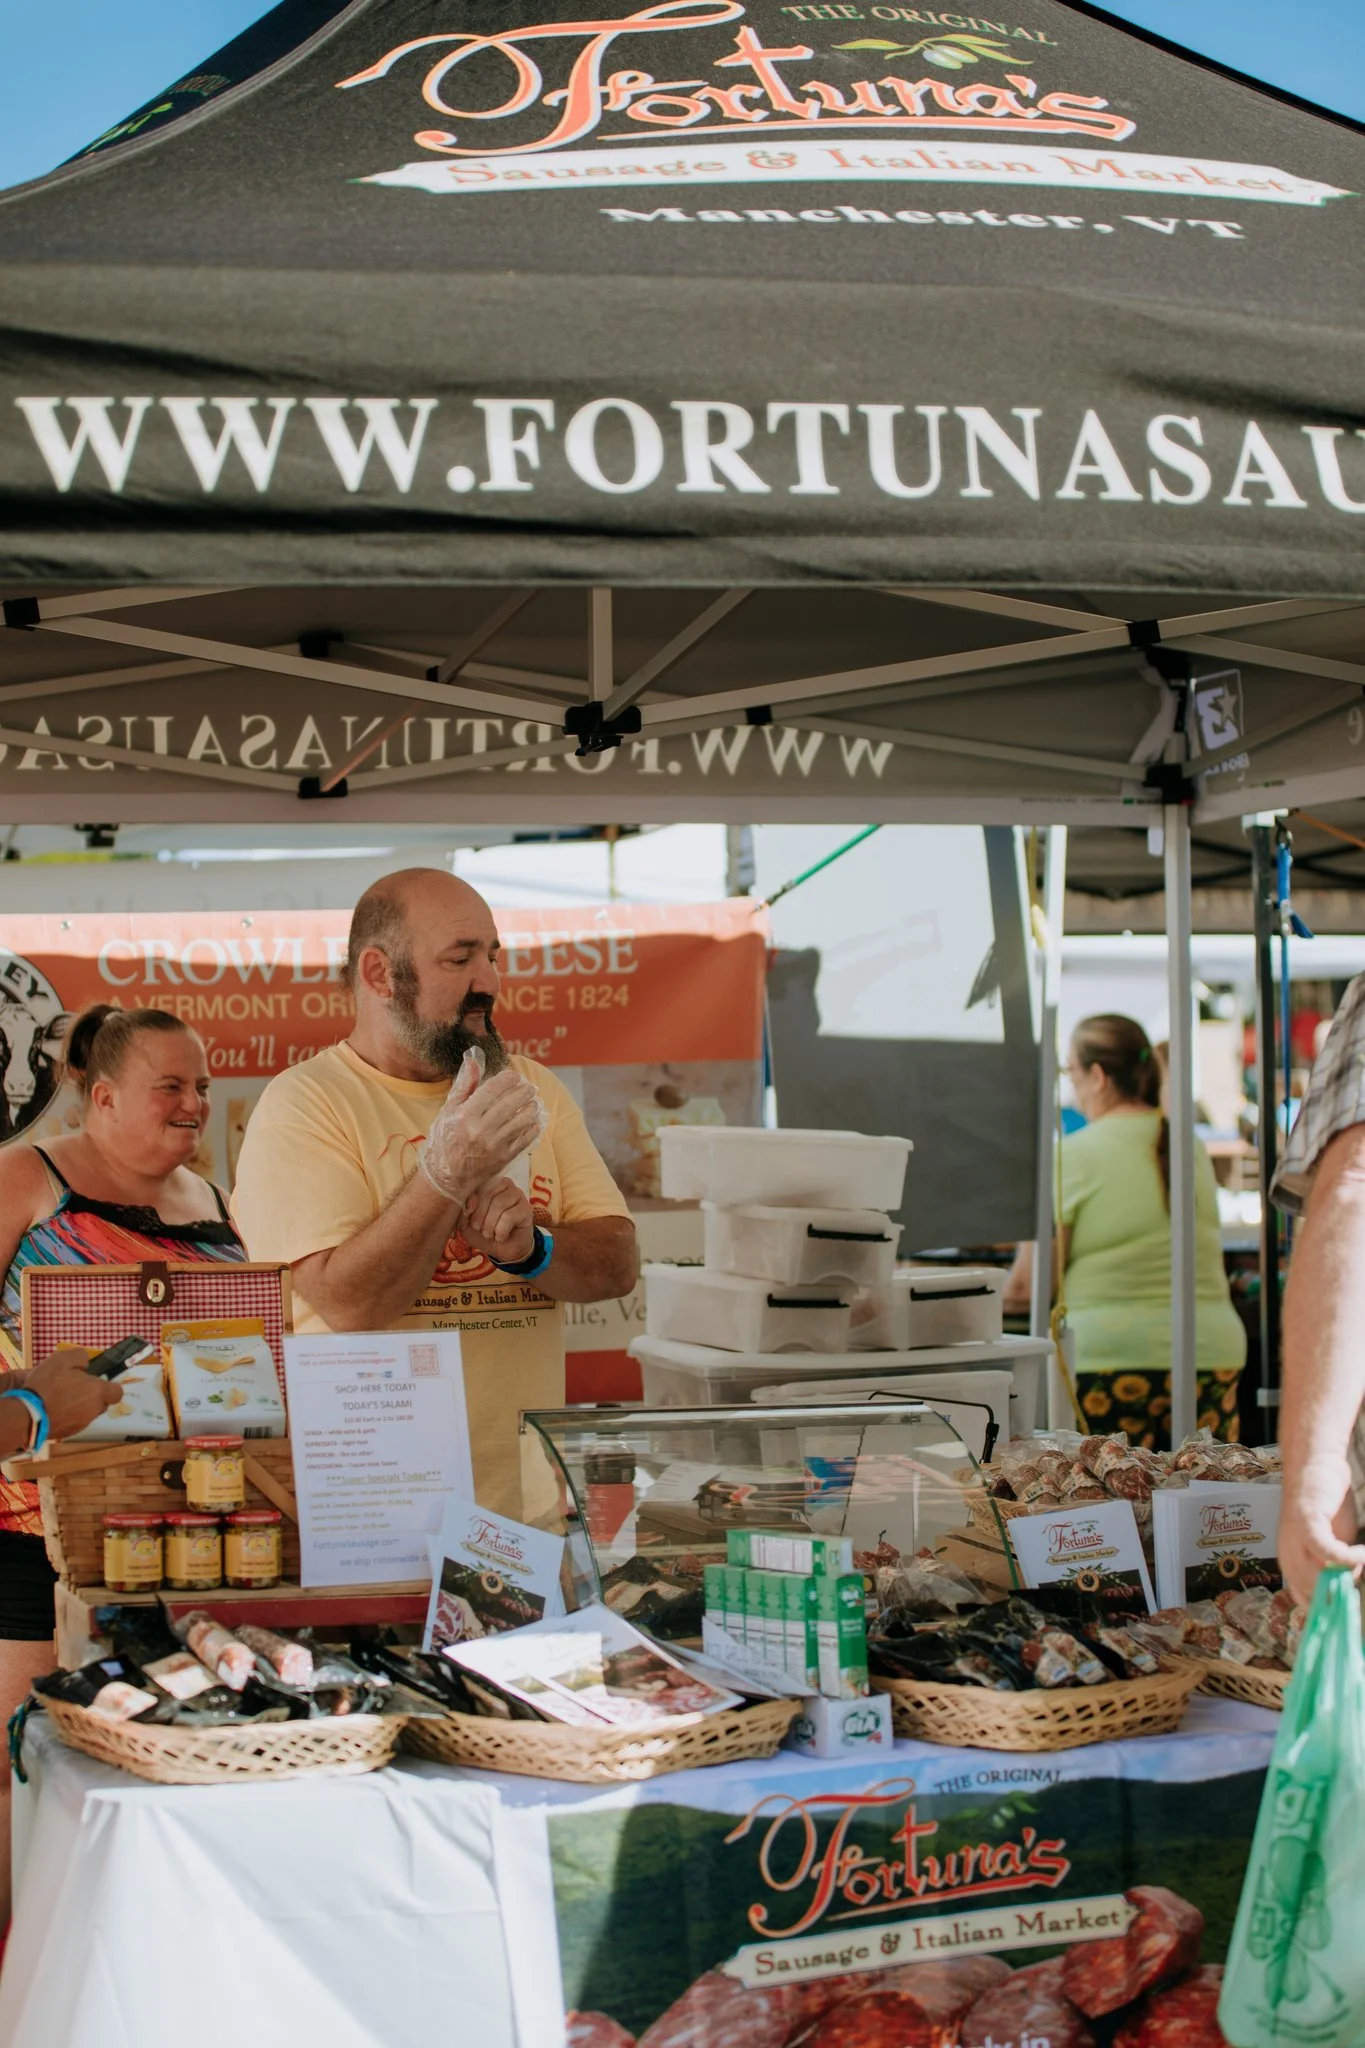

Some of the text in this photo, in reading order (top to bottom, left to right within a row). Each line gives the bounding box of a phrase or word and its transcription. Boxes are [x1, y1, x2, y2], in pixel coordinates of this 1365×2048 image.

[781, 4, 1059, 46] THE ORIGINAL
[335, 0, 1135, 156] Fortuna's
[447, 147, 1295, 194] Sausage & Italian Market
[600, 204, 1248, 240] Manchester, VT
[496, 928, 639, 978] EESE
[134, 992, 293, 1021] VERMONT
[567, 983, 630, 1010] 1824
[413, 1296, 458, 1309] ausage
[461, 1292, 473, 1306] &
[477, 1289, 518, 1304] Italian
[526, 1316, 538, 1327] VT
[335, 1382, 417, 1394] SHOP HERE TODAY!
[343, 1399, 413, 1411] TODAY'S SALAMI
[1042, 1519, 1105, 1556] Fortuna's
[933, 1768, 1063, 1796] THE ORIGINAL
[723, 1776, 1072, 1939] Fortuna's
[754, 1907, 1121, 1979] Sausage & Italian Market
